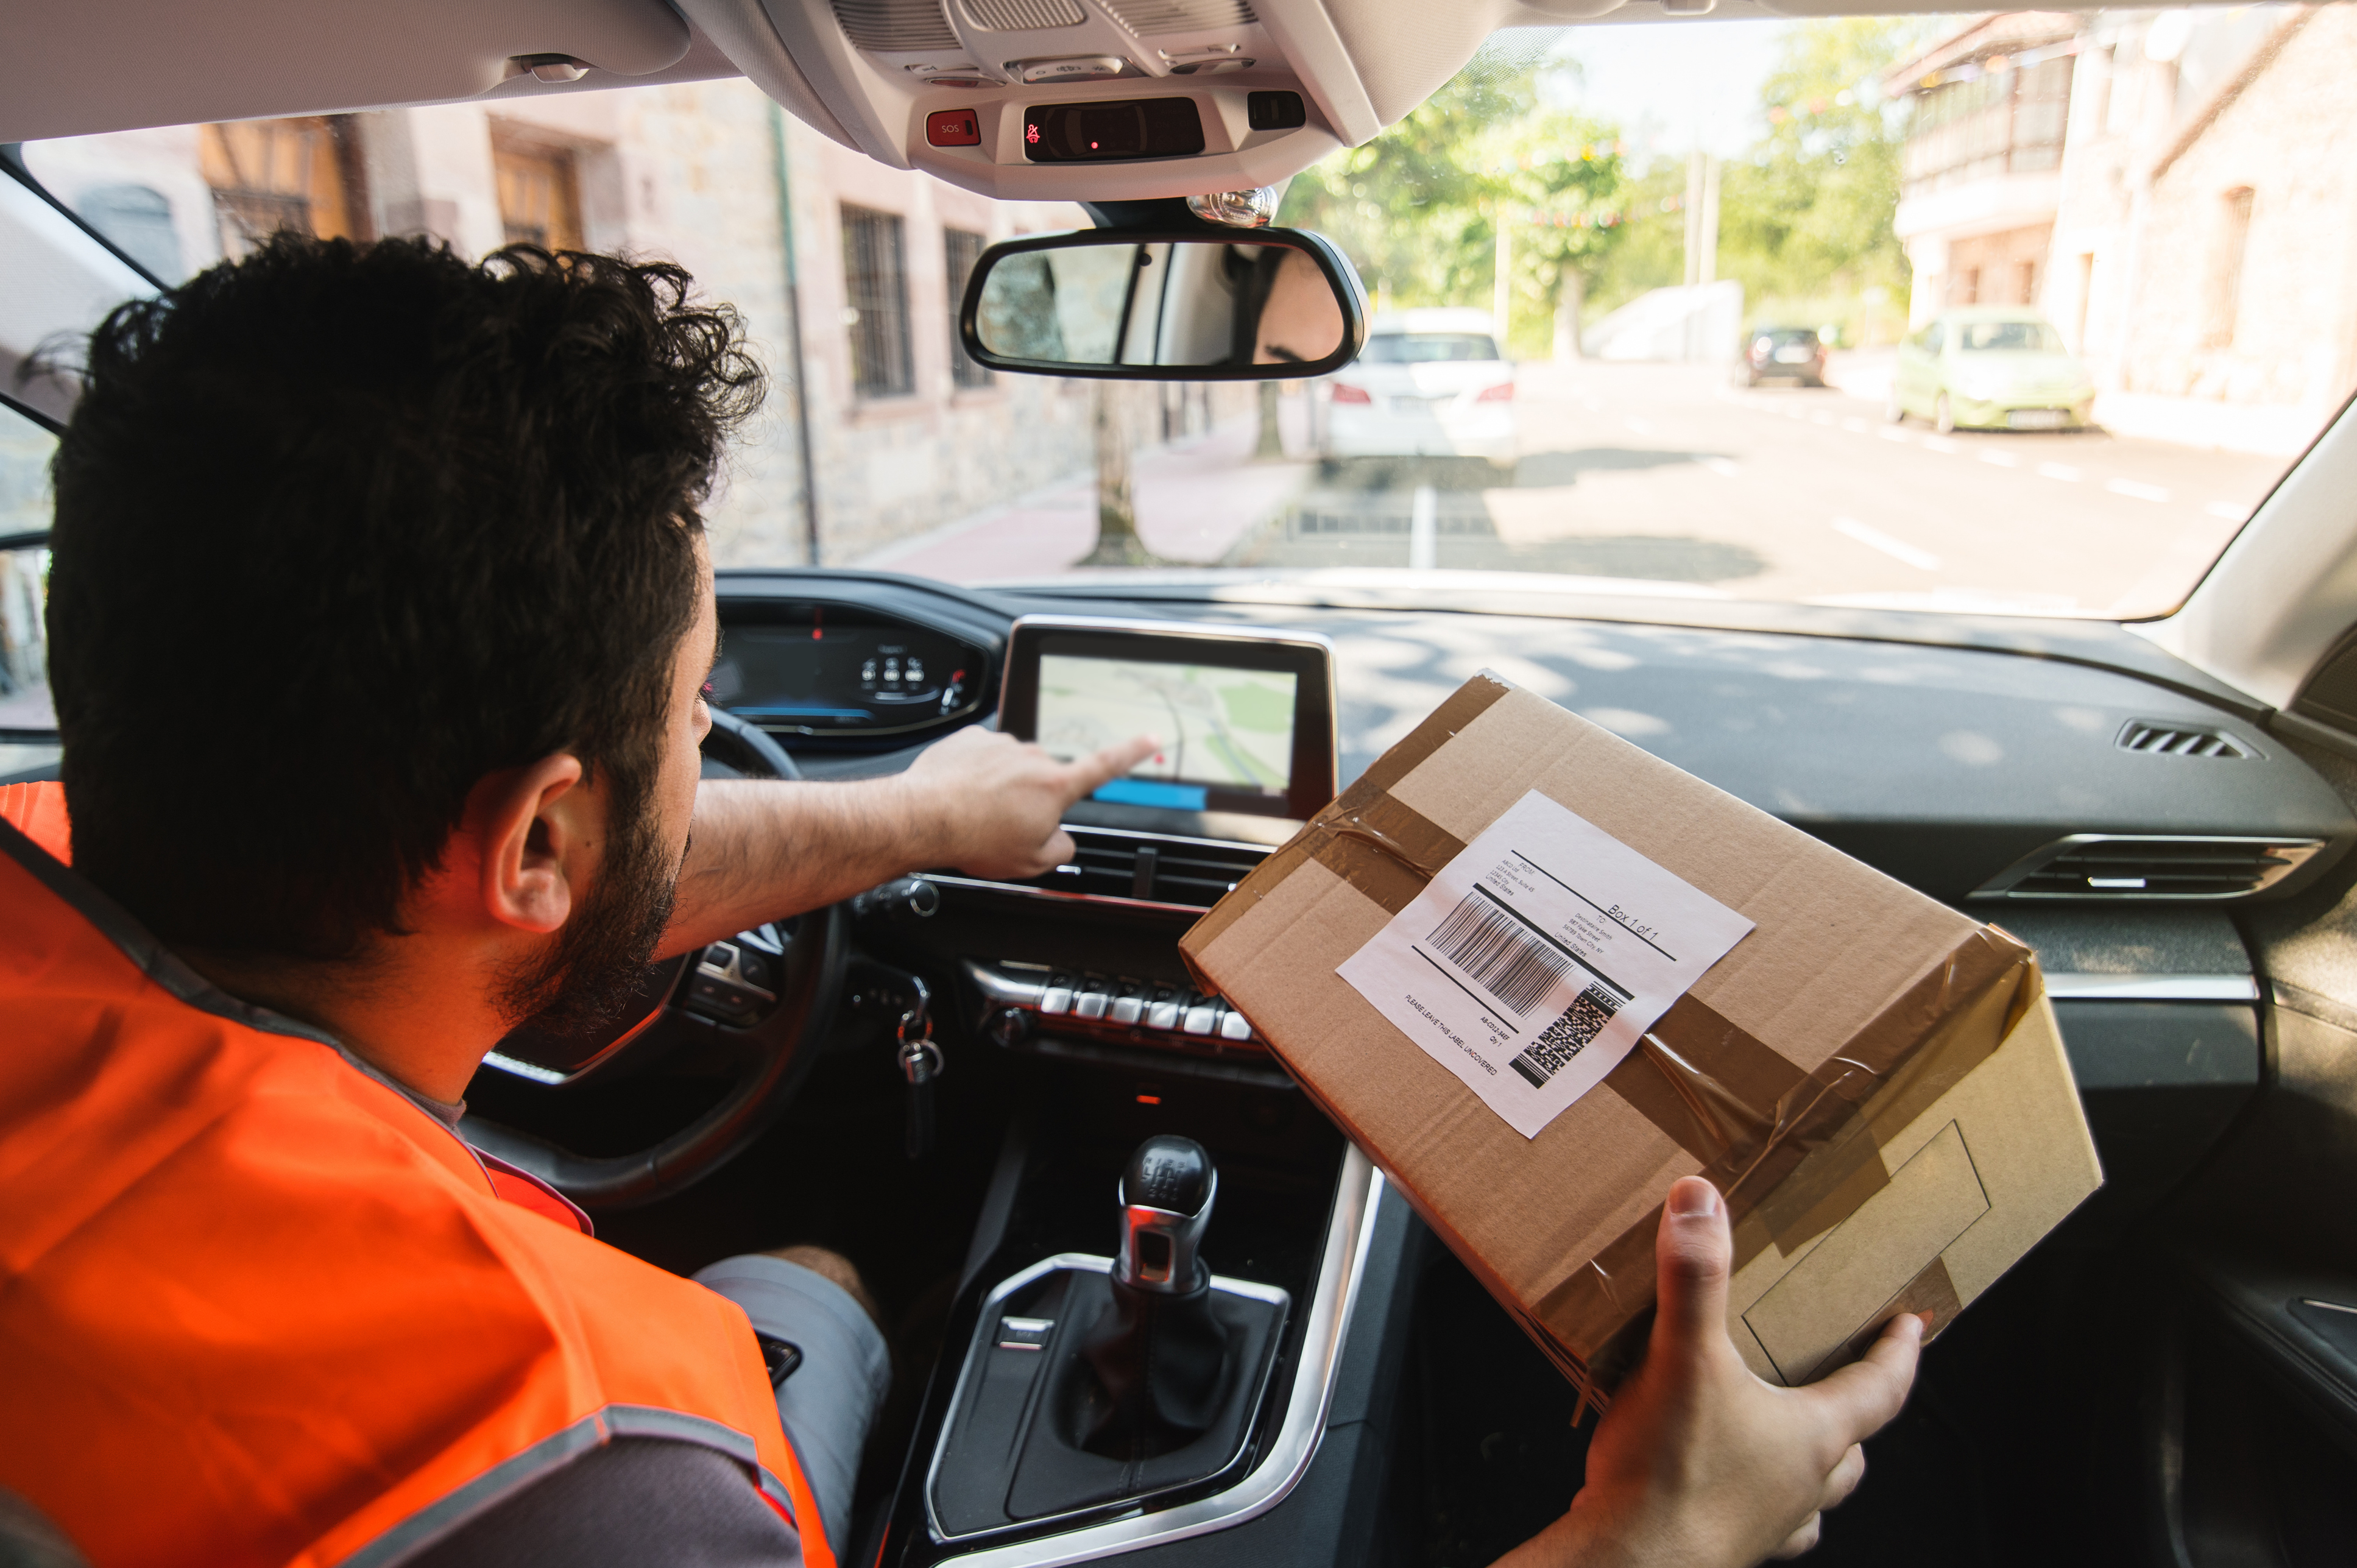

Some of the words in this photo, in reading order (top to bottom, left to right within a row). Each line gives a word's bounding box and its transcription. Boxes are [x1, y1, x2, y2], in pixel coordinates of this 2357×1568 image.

[941, 124, 959, 133] SOS
[1489, 869, 1503, 880] 12345
[1502, 860, 1513, 869] ABCD
[1485, 874, 1501, 886] United
[1499, 883, 1514, 896] States
[1518, 880, 1528, 889] Suite
[1568, 918, 1578, 927] 987
[1576, 924, 1588, 934] Fake
[1586, 930, 1600, 942] Street
[1574, 913, 1600, 932] Destinataire
[1599, 930, 1613, 941] Smith
[1595, 915, 1607, 925] TO:
[1608, 904, 1630, 923] Box
[1629, 919, 1639, 928] 1
[1636, 925, 1652, 936] of
[1649, 932, 1659, 941] 1
[1554, 931, 1572, 945] United
[1570, 943, 1587, 958] States
[1562, 924, 1577, 935] 56789
[1575, 933, 1588, 944] Town
[1586, 941, 1595, 950] City,
[1404, 994, 1424, 1012] PLEASE
[1421, 1009, 1440, 1026] LEAVE
[1437, 1022, 1451, 1035] THIS
[1447, 1033, 1466, 1048] LABEL
[1463, 1045, 1497, 1076] UNCOVERED
[1480, 1016, 1510, 1041] AB-CD12-34EF
[1489, 1036, 1499, 1045] Qty
